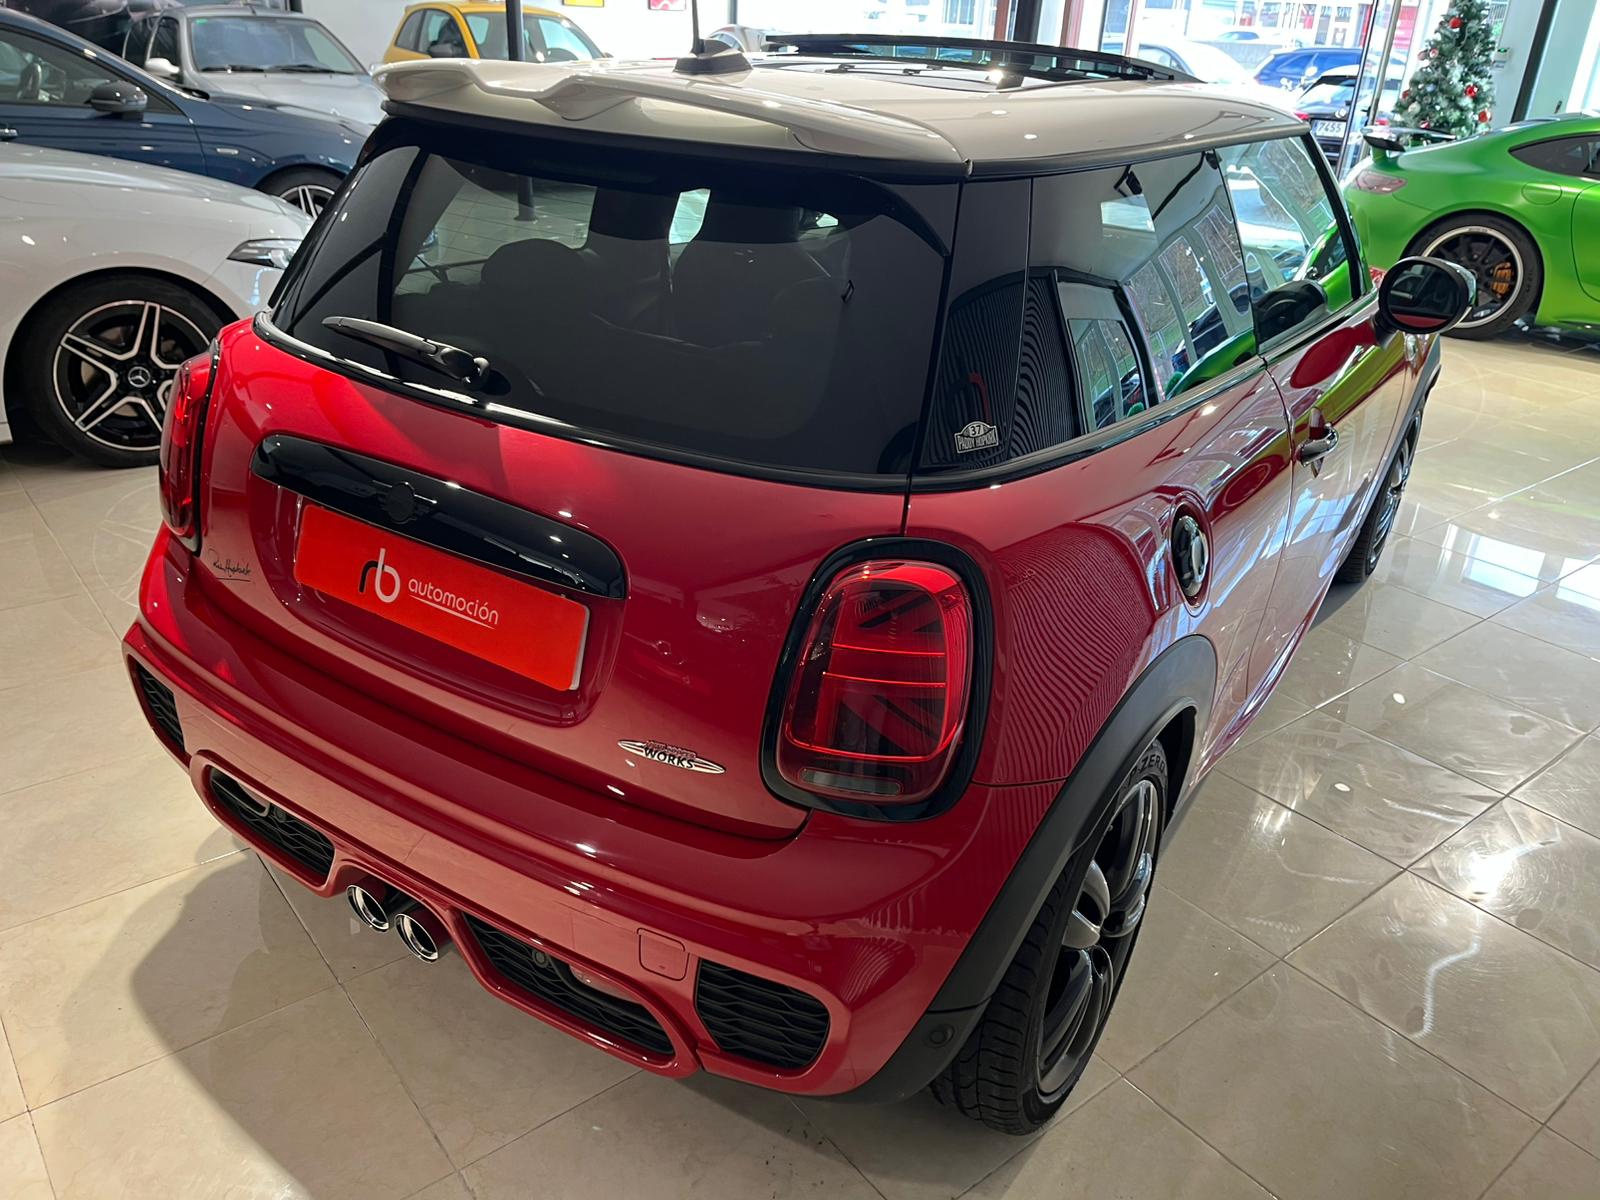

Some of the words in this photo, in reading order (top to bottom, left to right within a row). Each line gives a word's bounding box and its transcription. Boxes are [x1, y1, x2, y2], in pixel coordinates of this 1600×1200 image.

[970, 425, 981, 436] 37
[408, 578, 499, 625] automoción
[644, 747, 695, 769] WORKS
